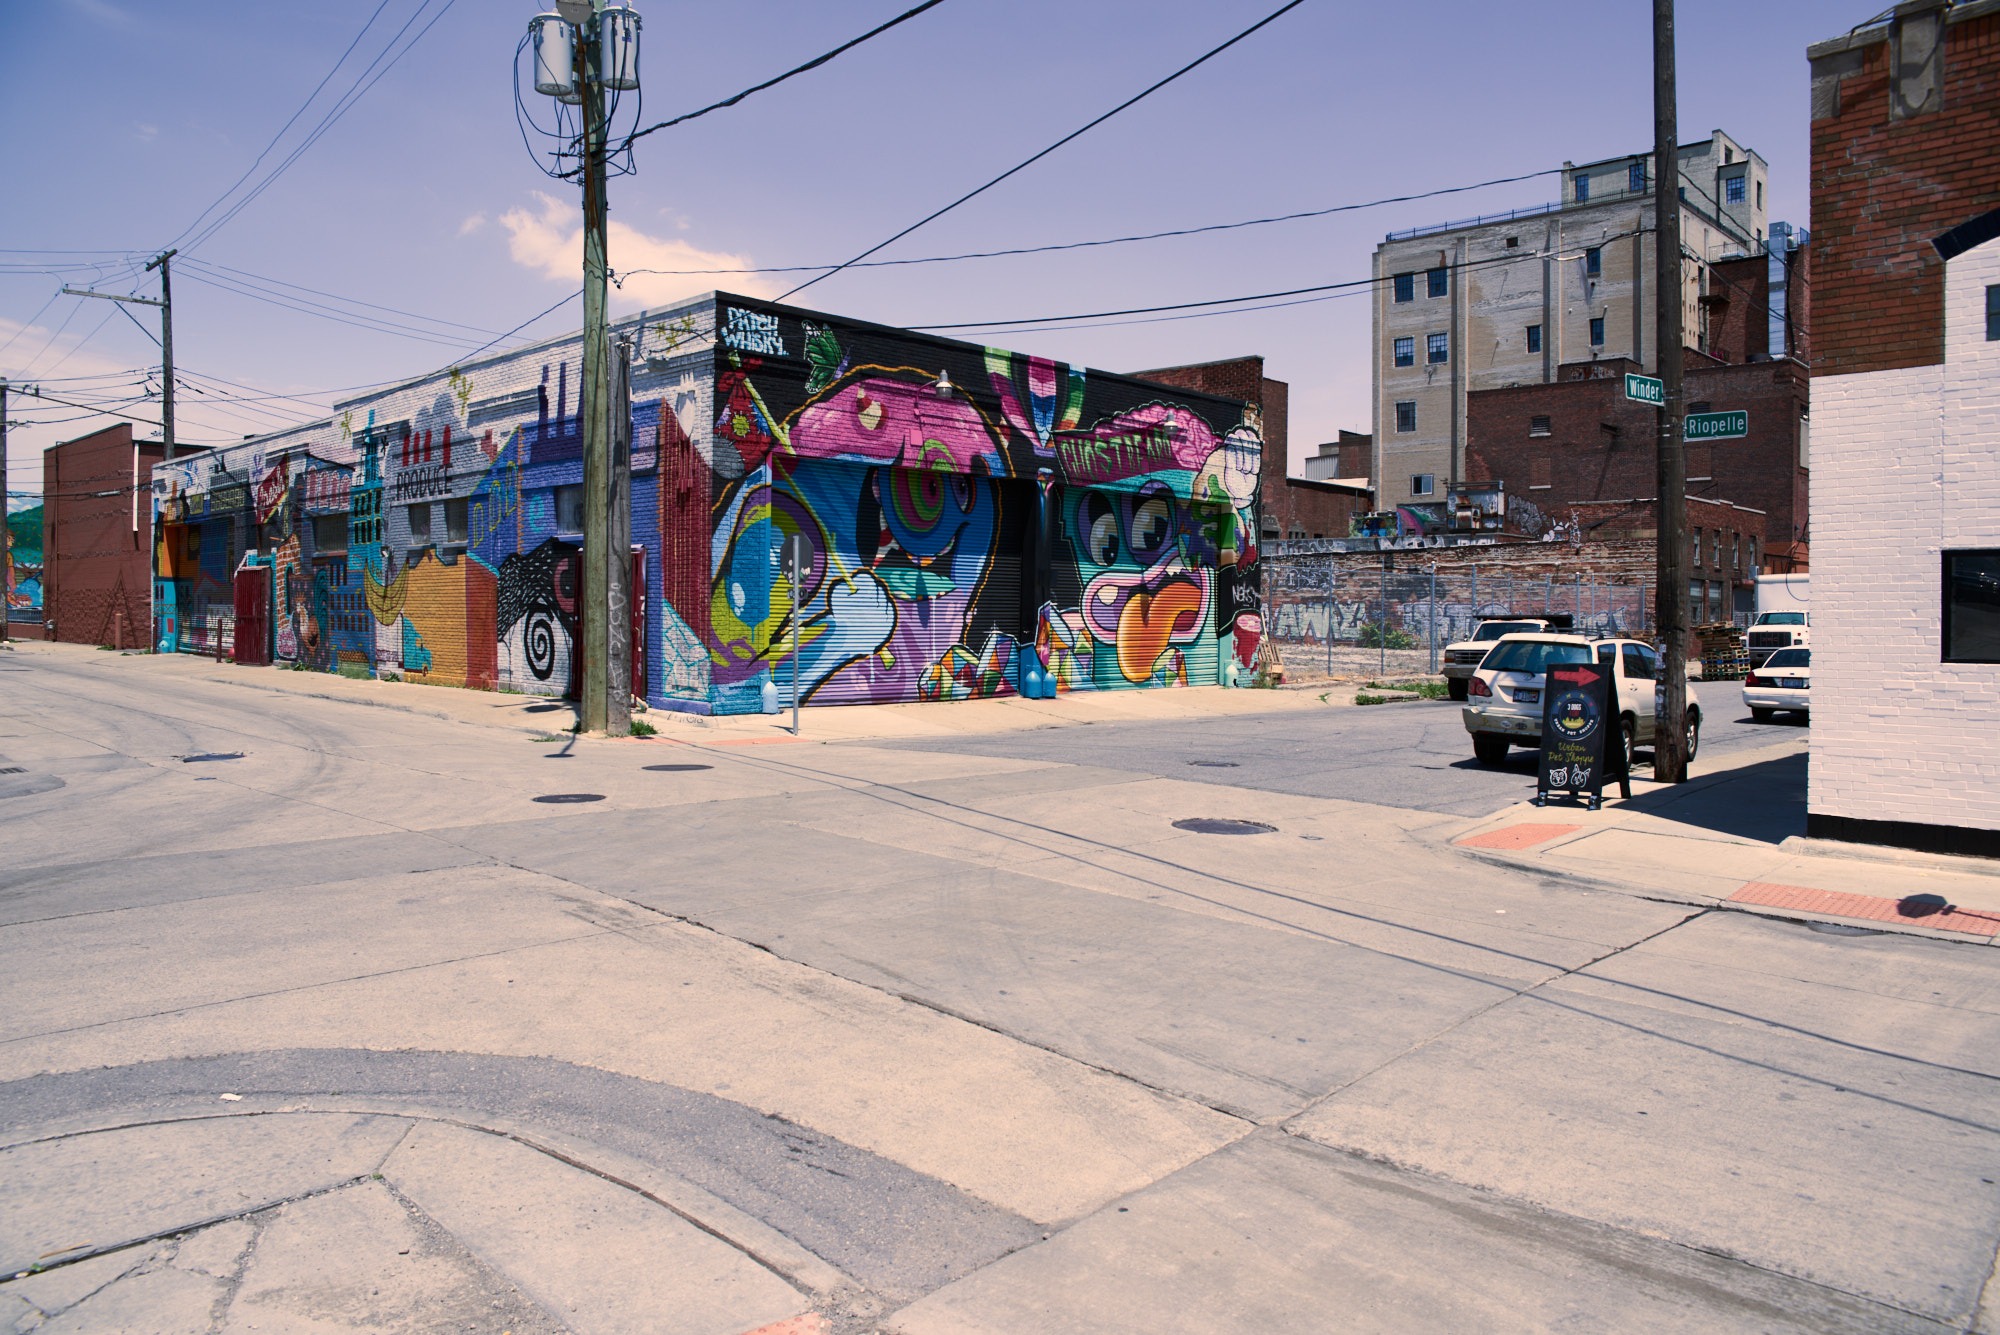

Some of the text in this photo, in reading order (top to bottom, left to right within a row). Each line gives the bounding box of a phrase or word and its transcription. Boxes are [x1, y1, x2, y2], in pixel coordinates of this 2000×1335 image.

[727, 306, 779, 334] PATCH
[1630, 379, 1659, 399] Winder
[1690, 416, 1744, 434] Riopelle
[396, 464, 453, 501] PRODUCE
[1558, 742, 1585, 751] Urban
[1548, 752, 1594, 765] Pet Shoppe
